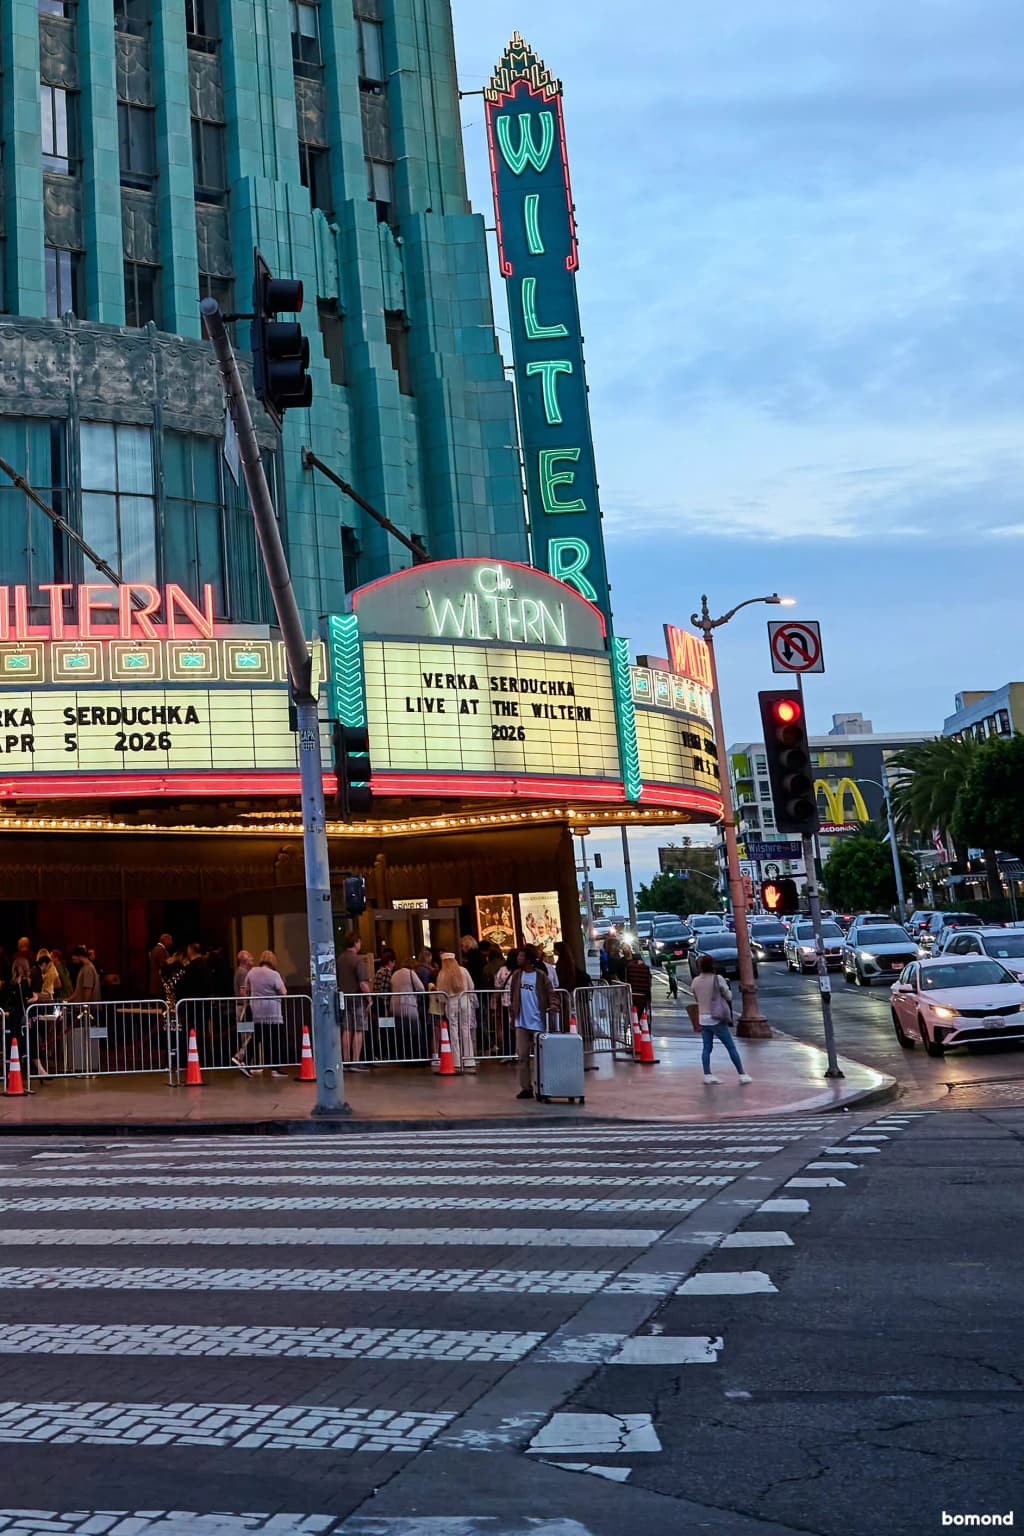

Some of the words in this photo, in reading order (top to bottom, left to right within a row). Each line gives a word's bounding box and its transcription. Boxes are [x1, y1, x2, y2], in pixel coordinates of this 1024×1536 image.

[496, 111, 598, 602] WILTER
[425, 590, 567, 646] WILTERN
[423, 672, 479, 690] VERKA
[490, 676, 575, 697] SERDUCHKA
[63, 705, 200, 726] SERDUCHKA
[406, 697, 445, 714] LIVE
[460, 699, 479, 714] AT
[492, 700, 519, 717] THE
[531, 703, 591, 721] WILTERN
[64, 733, 77, 752] 5
[114, 731, 172, 752] 2026
[491, 724, 526, 742] 2026
[747, 842, 782, 853] Wilshire
